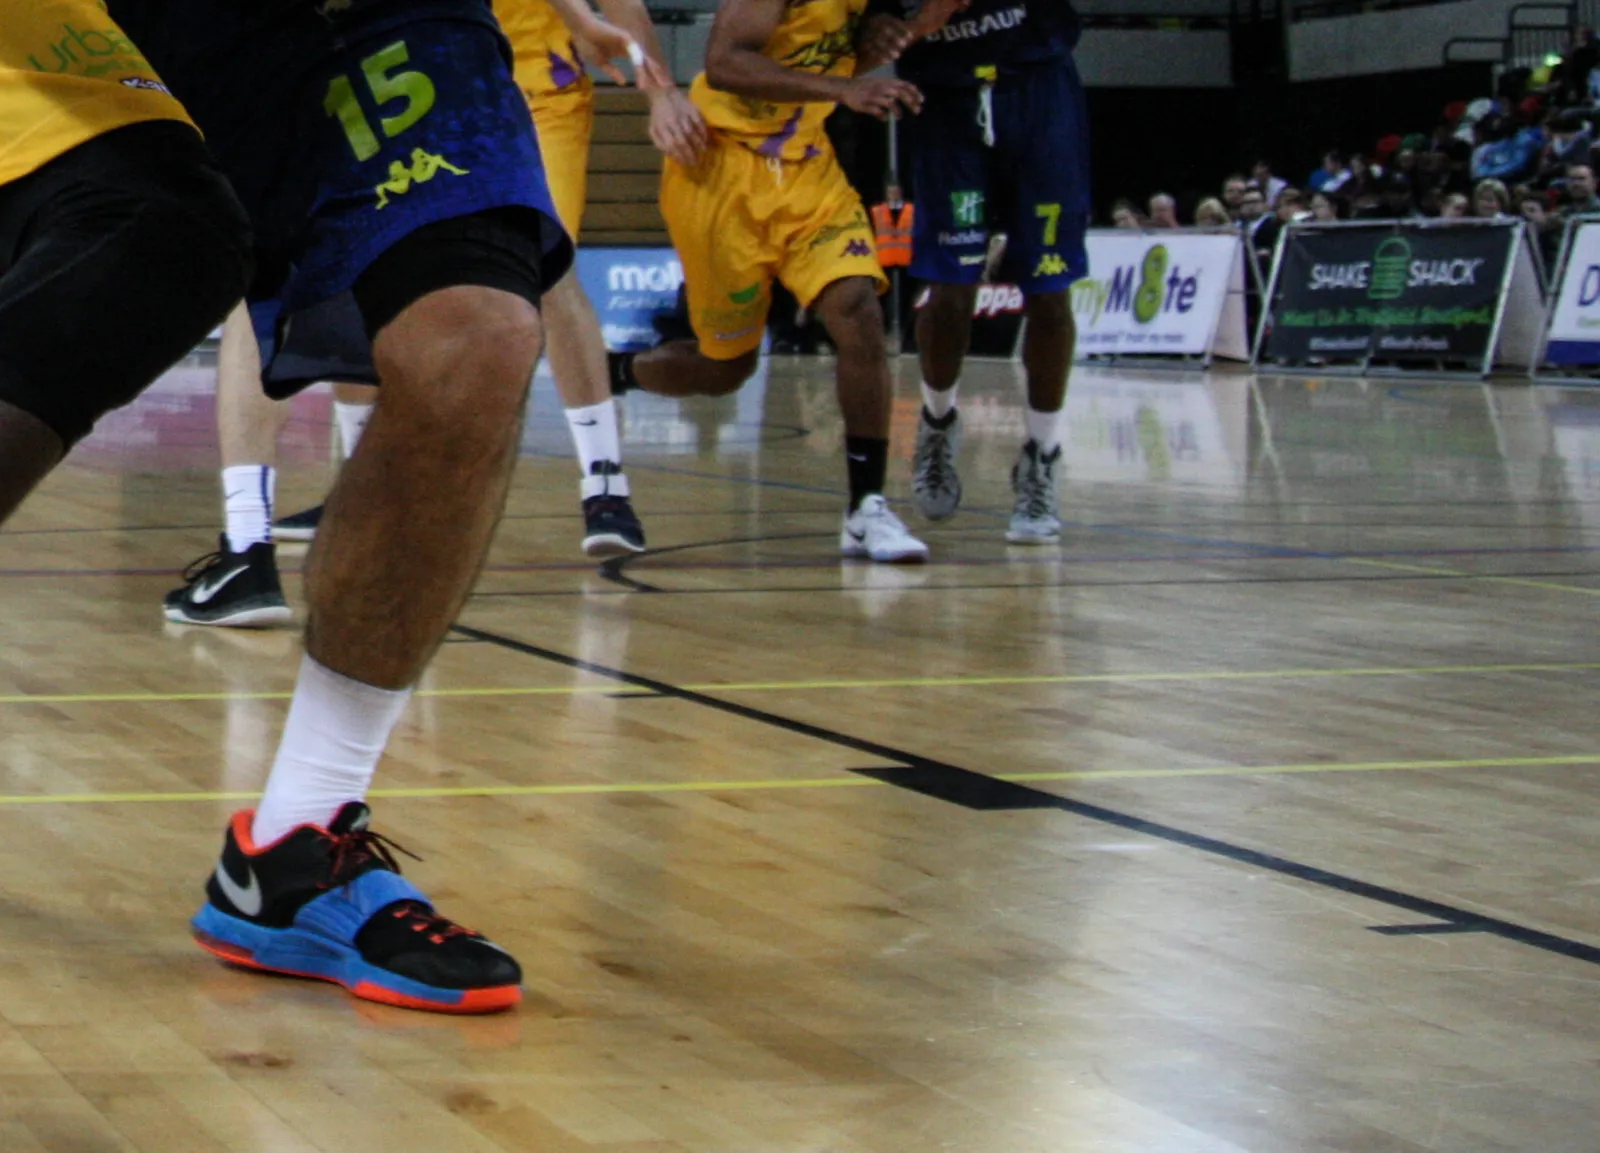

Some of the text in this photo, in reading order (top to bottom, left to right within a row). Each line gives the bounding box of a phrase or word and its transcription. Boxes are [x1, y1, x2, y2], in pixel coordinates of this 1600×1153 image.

[322, 39, 437, 163] 15
[1033, 203, 1062, 246] 7
[1308, 258, 1484, 290] SHAKE SHACK
